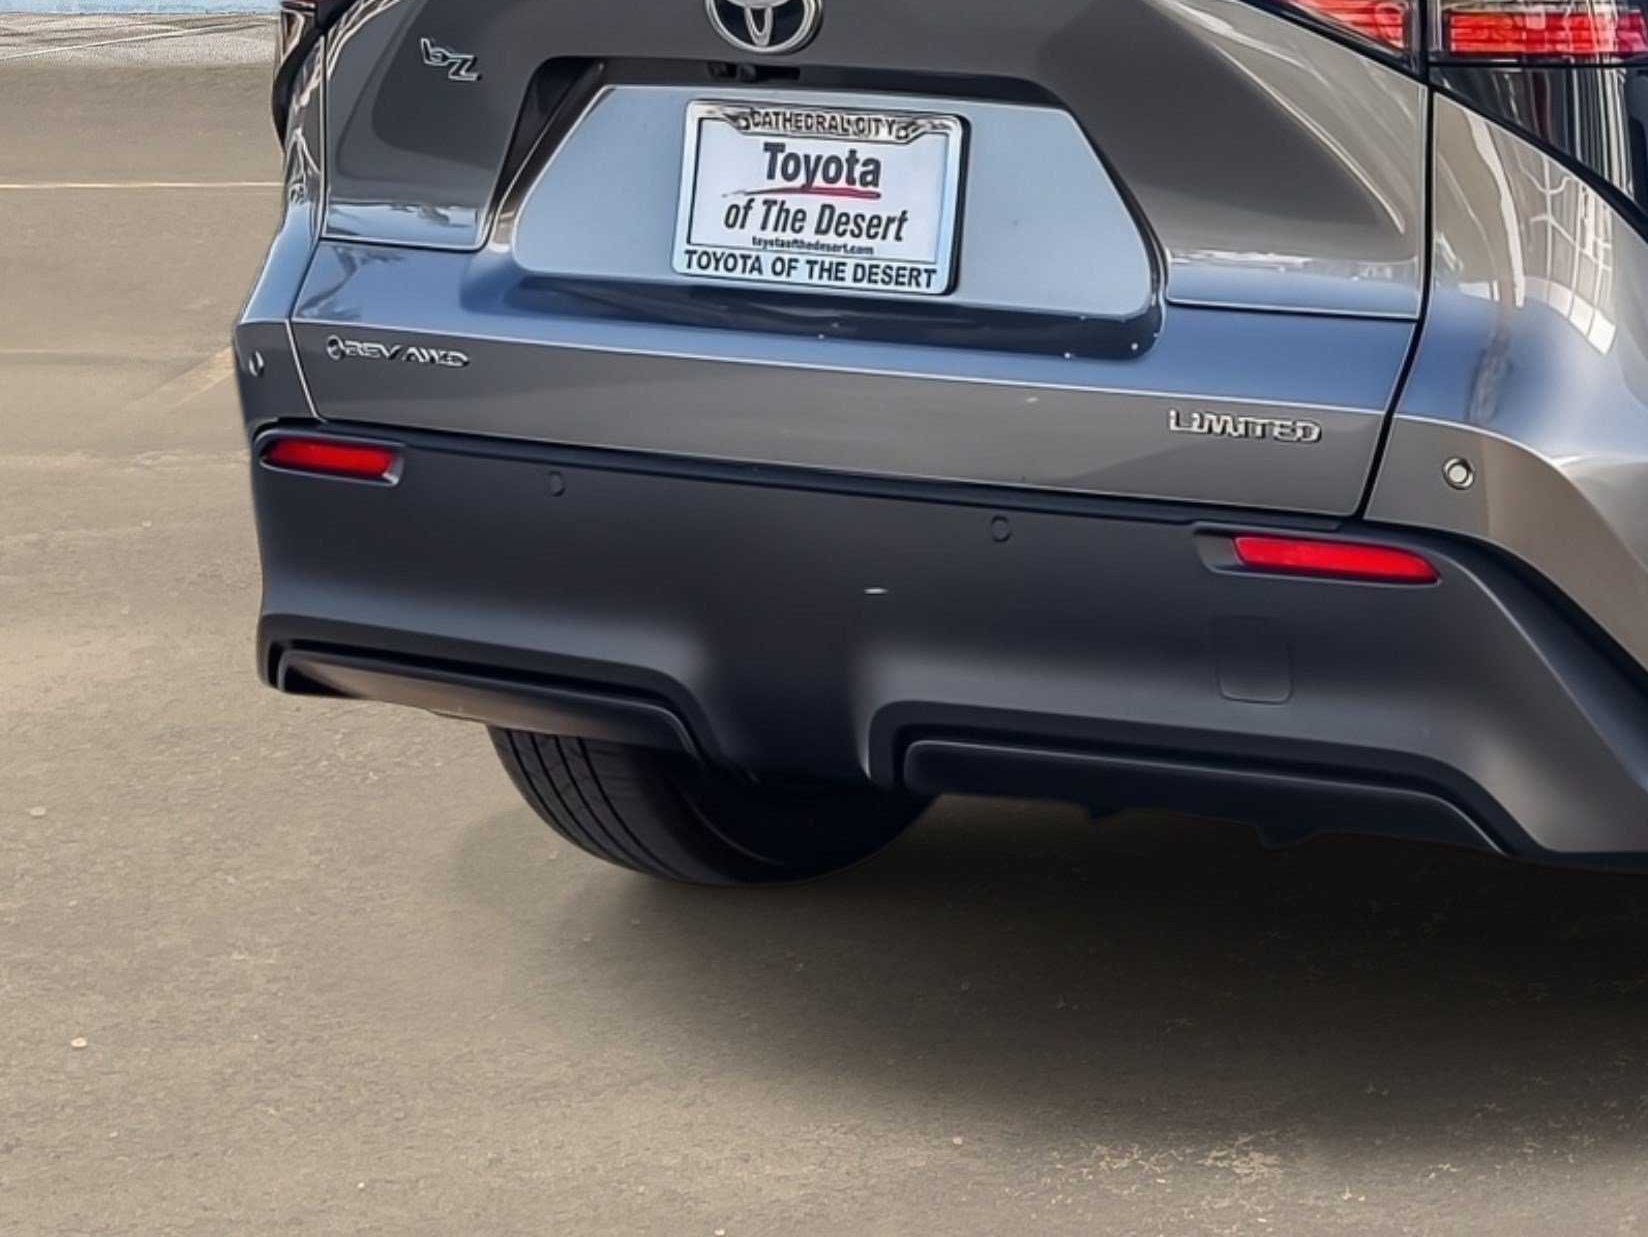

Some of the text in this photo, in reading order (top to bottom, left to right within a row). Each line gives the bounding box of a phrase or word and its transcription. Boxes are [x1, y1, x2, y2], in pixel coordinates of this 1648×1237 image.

[856, 116, 897, 137] CITY
[763, 142, 881, 189] Toyota
[725, 198, 908, 241] of The Desert
[752, 235, 874, 255] toyotaofthedesert.com
[684, 250, 937, 289] TOYOTA OF THE DESERT
[402, 346, 470, 367] AWD
[1170, 410, 1322, 443] LIMITED
